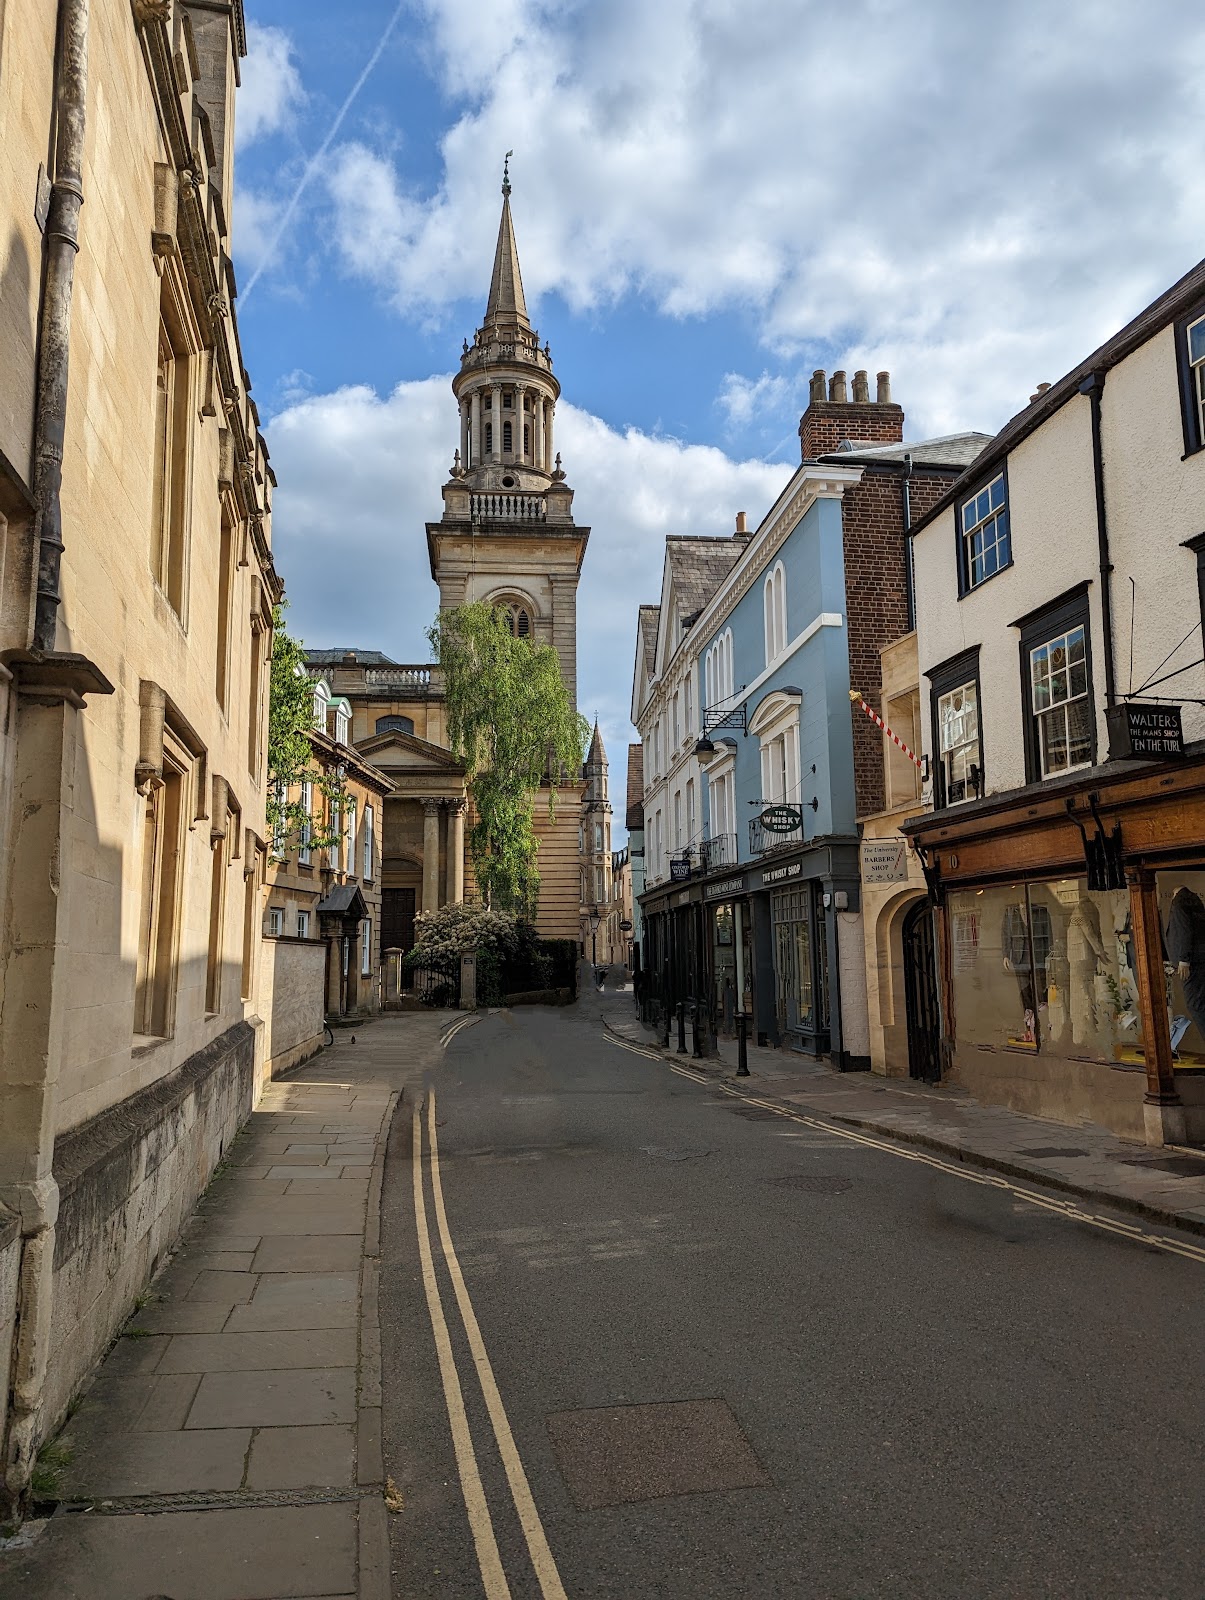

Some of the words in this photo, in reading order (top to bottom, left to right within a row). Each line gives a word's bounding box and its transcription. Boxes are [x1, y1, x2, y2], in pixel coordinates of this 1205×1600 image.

[1129, 713, 1178, 728] WALTERS
[1130, 728, 1141, 736] THE
[1163, 729, 1180, 738] SHOP
[1146, 738, 1162, 752] THE
[1162, 739, 1182, 752] TURL
[763, 816, 801, 824] WHISKY
[948, 854, 958, 869] 10
[762, 872, 771, 882] THE
[788, 863, 801, 876] SHOP
